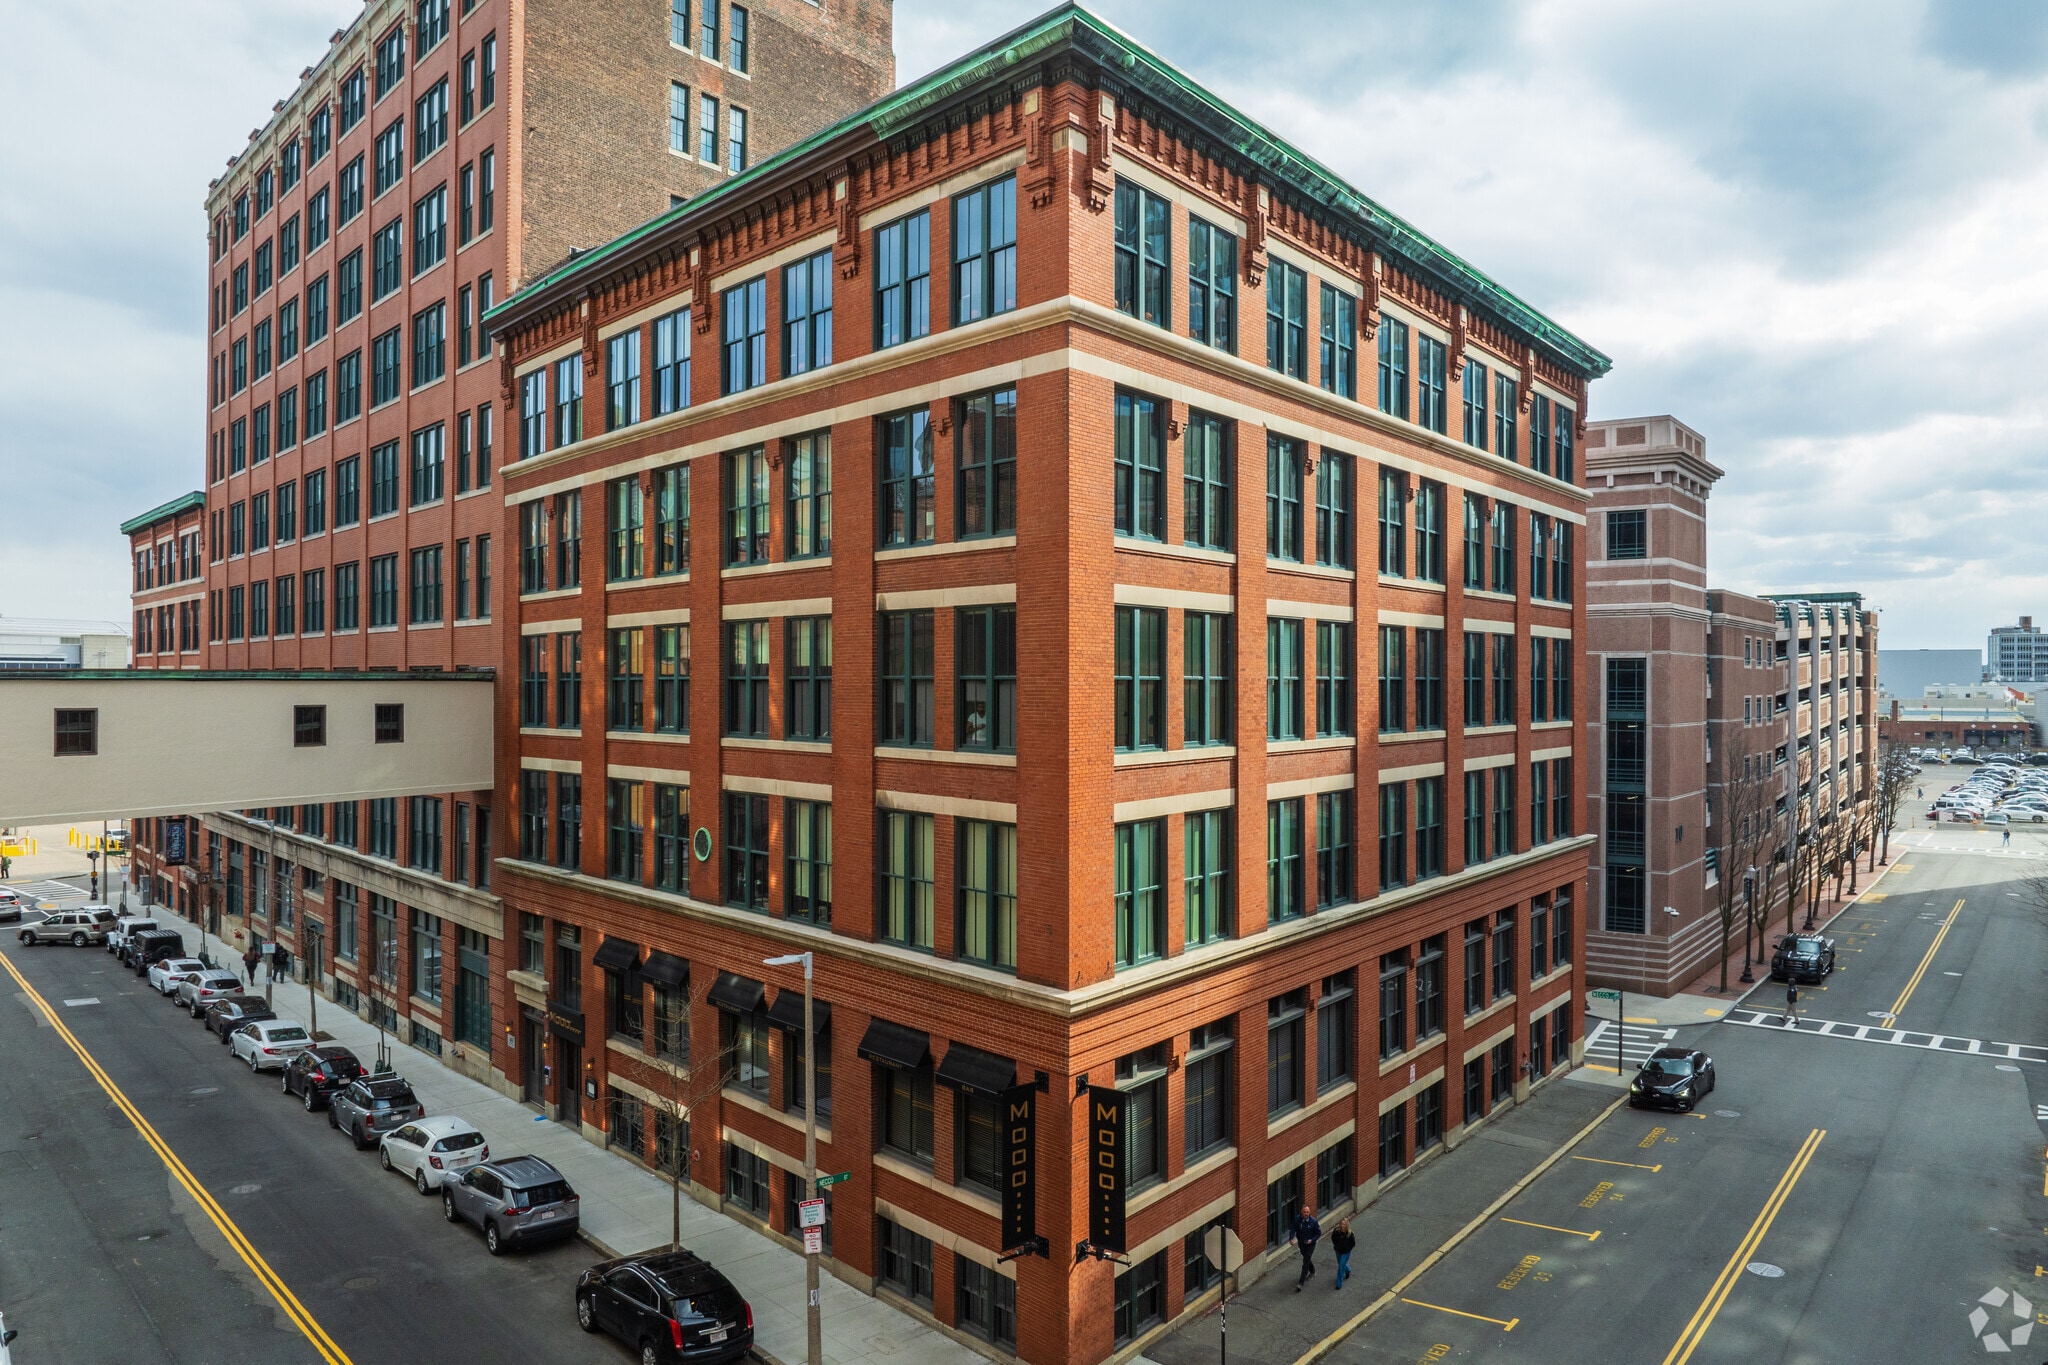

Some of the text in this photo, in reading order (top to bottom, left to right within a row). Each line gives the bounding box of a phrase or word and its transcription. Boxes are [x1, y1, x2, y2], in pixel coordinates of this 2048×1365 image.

[868, 1053, 902, 1070] RESTAURANT
[961, 1084, 974, 1094] BAR
[819, 1177, 834, 1187] NECCO
[1578, 1181, 1614, 1209] RESERVED
[1496, 1254, 1541, 1290] RESERVED
